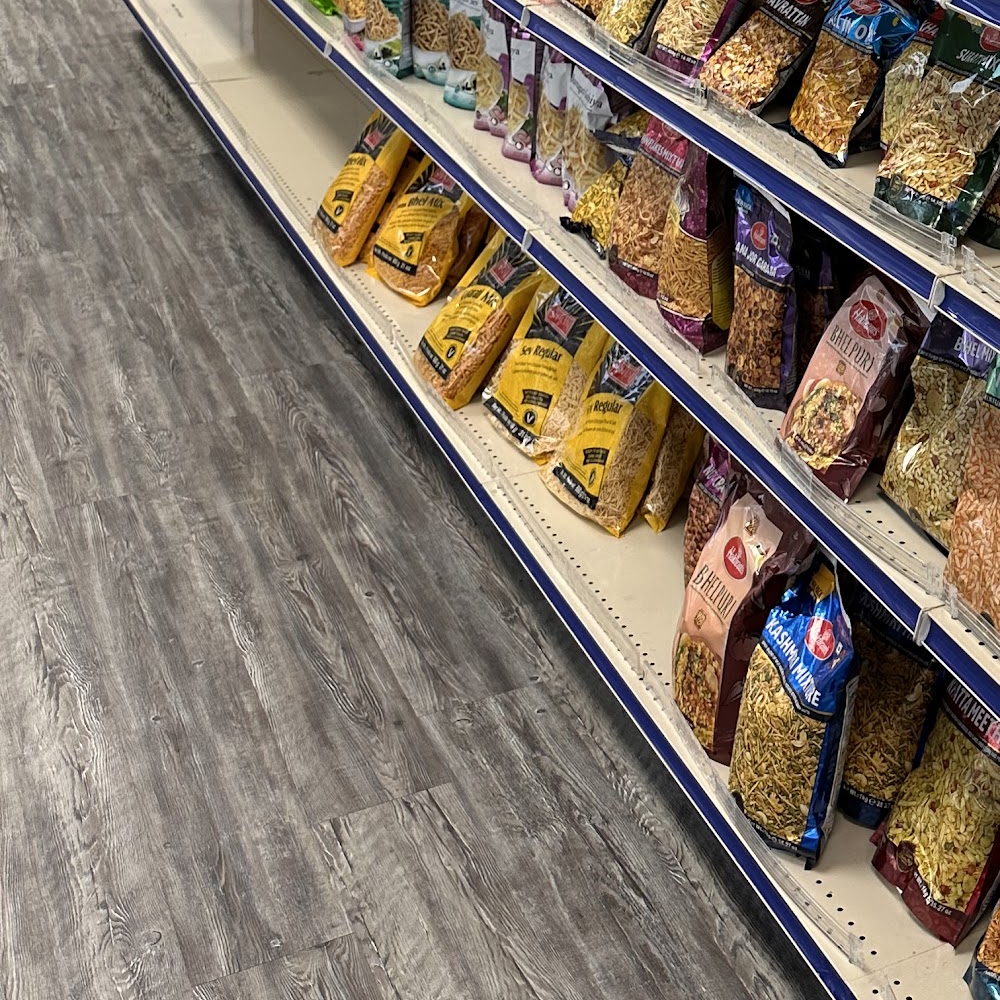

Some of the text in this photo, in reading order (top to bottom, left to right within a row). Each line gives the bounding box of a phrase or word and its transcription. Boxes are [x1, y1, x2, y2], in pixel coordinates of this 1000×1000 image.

[521, 345, 562, 363] Sev Regular
[594, 400, 623, 415] Regular
